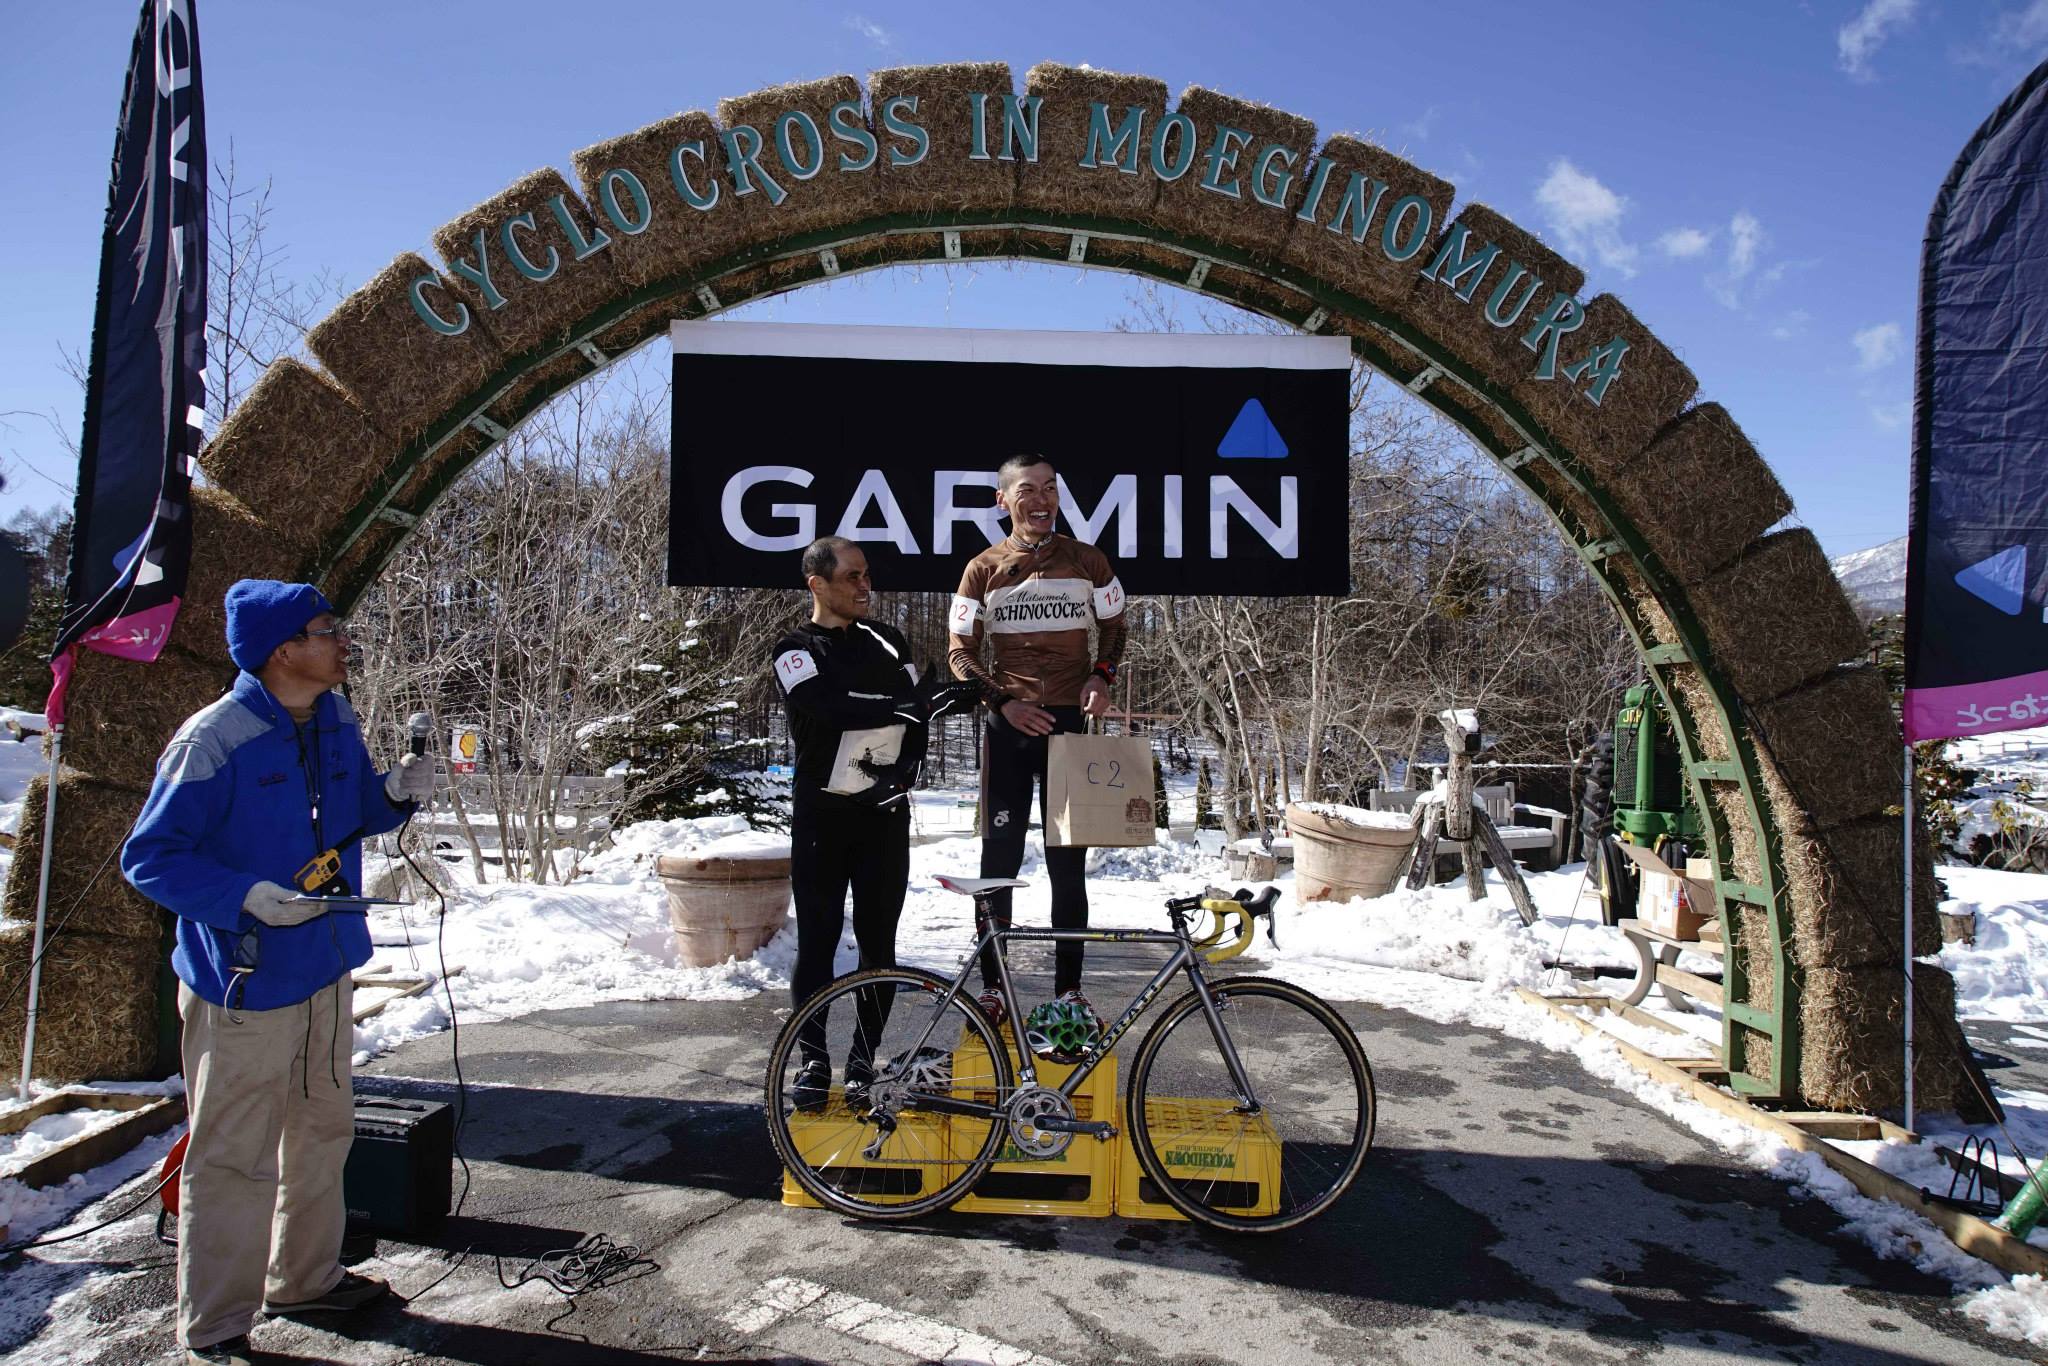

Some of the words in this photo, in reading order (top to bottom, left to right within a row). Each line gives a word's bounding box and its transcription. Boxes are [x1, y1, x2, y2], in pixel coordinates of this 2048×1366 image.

[407, 167, 653, 337] CYCLO
[669, 96, 930, 211] CROSS
[968, 92, 1043, 163] IN
[1078, 101, 1632, 407] MOEGINOMURA
[720, 465, 1299, 560] GARMIN
[1007, 591, 1070, 603] Matsumoto
[1104, 585, 1121, 606] 12
[782, 652, 803, 674] 15
[1083, 985, 1158, 1070] MORATI
